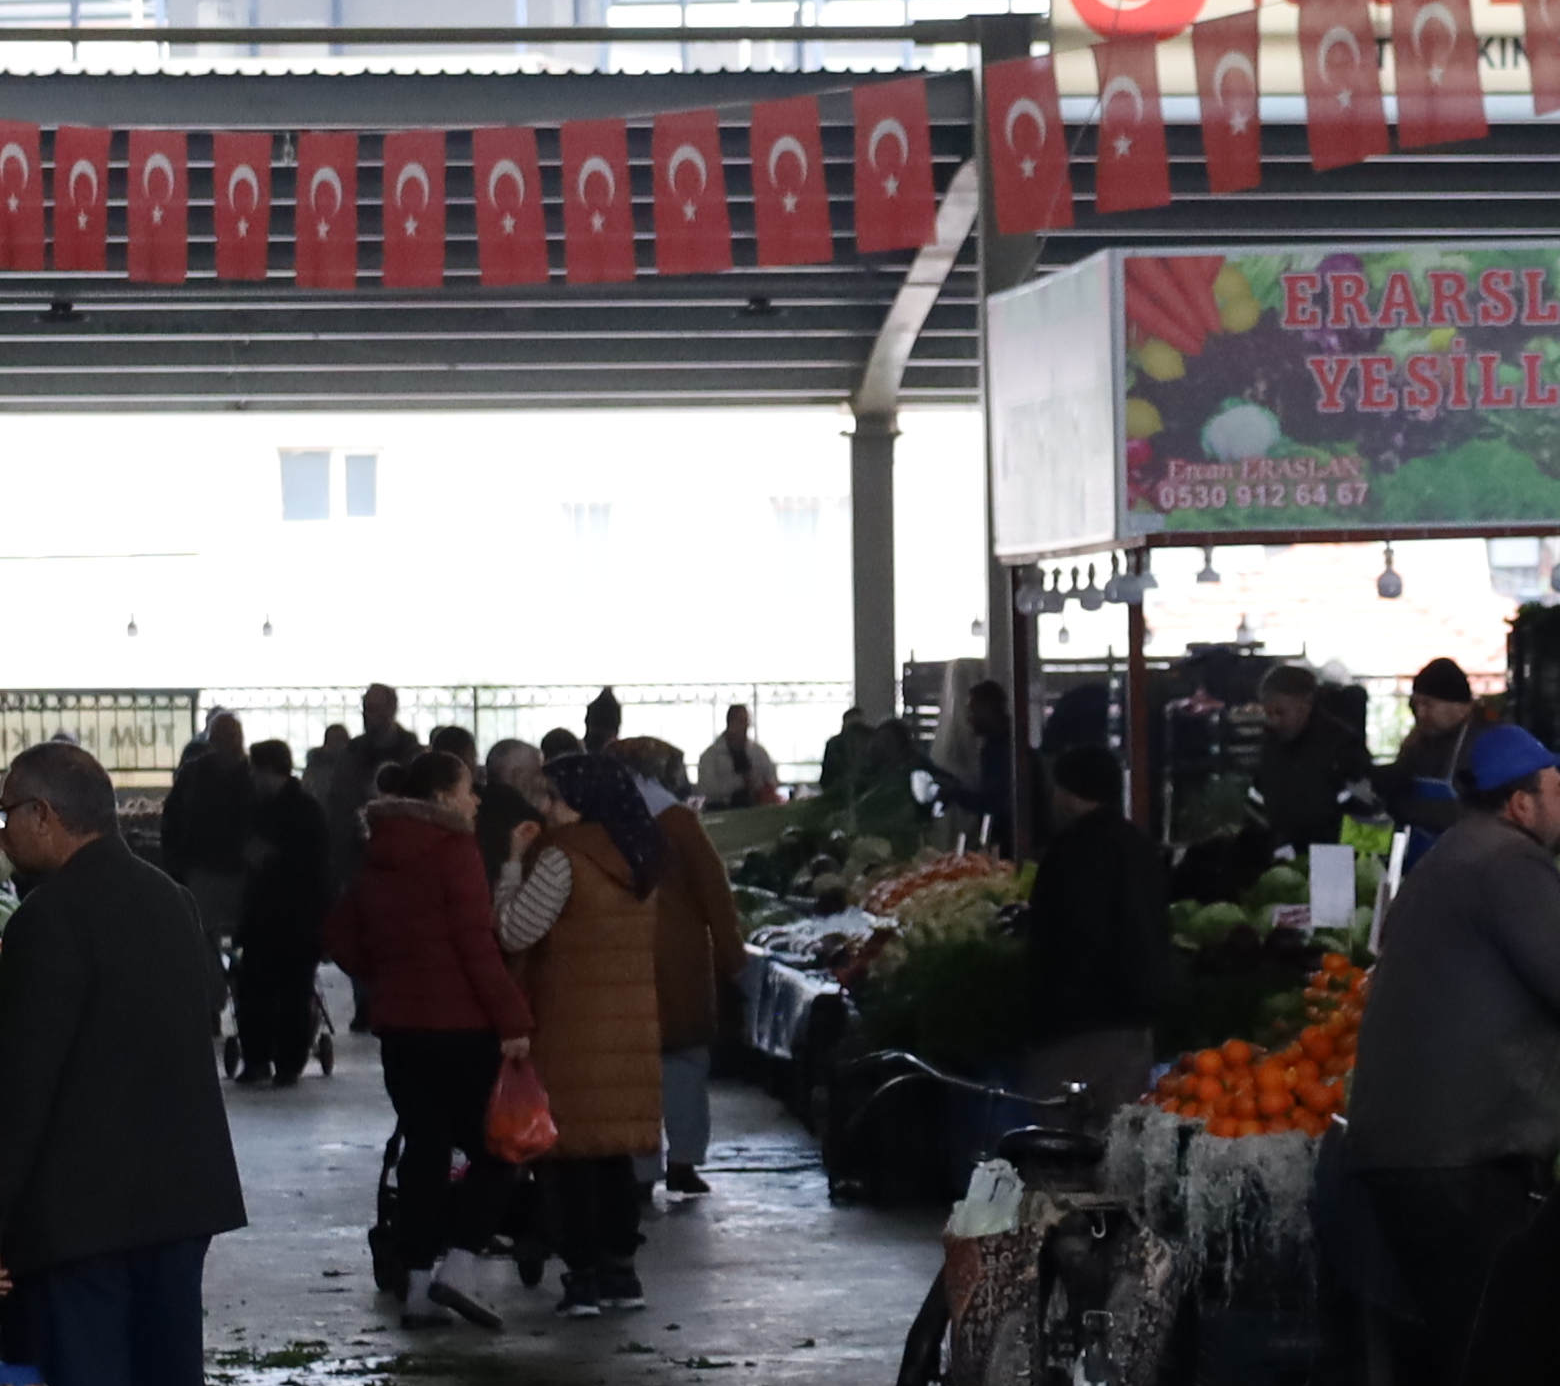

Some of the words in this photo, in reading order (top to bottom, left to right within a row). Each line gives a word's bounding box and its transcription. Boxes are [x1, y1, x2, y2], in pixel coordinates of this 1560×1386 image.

[1158, 484, 1228, 509] 0530
[1234, 483, 1287, 508] 912
[1294, 482, 1328, 506] 64
[1336, 481, 1369, 505] 67
